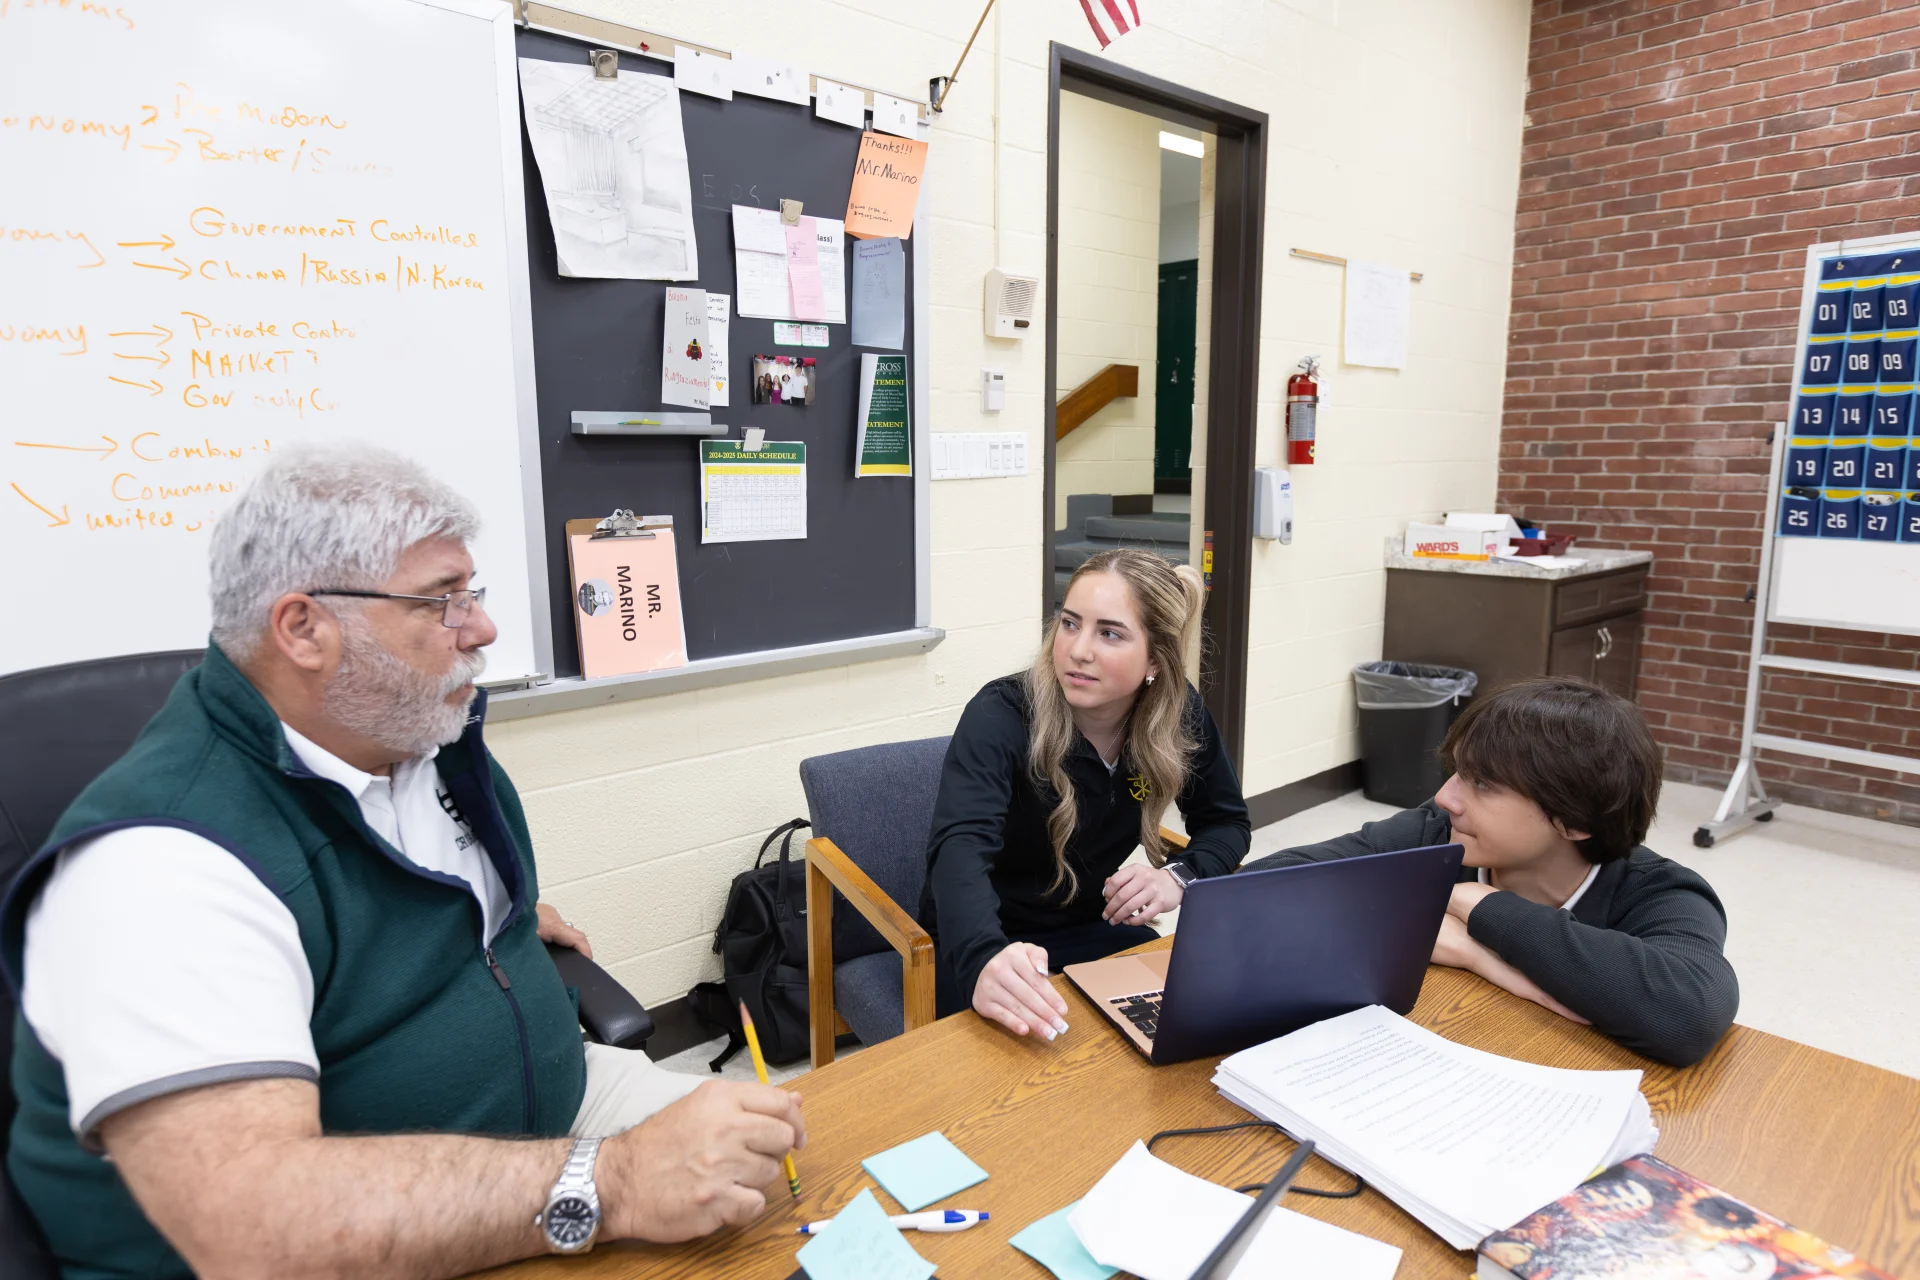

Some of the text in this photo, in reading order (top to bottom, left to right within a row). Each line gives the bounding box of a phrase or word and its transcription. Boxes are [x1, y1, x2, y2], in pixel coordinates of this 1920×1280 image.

[864, 136, 913, 156] Thanks!!!
[1819, 299, 1908, 321] 01 02 03
[1810, 353, 1902, 372] 07 08 09
[1802, 407, 1898, 424] 13 14 15
[758, 452, 797, 460] SCHEDULE
[1796, 460, 1893, 478] 19 20 21
[1788, 509, 1809, 527] 25
[1826, 512, 1848, 529] 26
[1867, 514, 1888, 532] 27
[1416, 541, 1459, 552] WARD'S
[616, 565, 637, 642] MARINO
[646, 584, 662, 619] MR.
